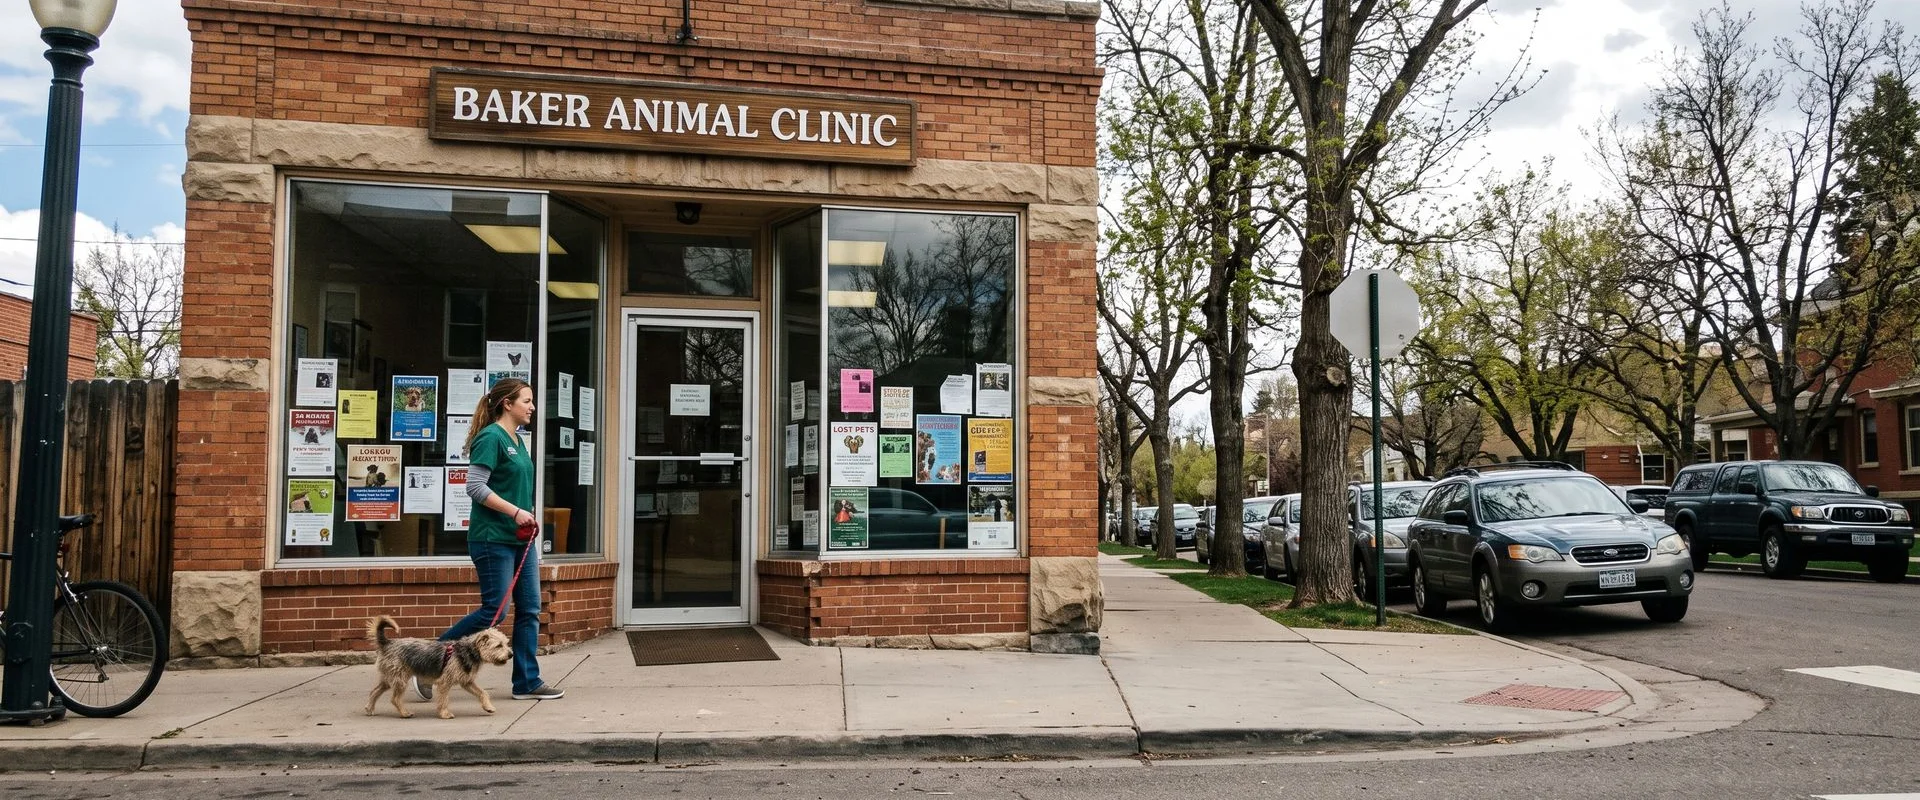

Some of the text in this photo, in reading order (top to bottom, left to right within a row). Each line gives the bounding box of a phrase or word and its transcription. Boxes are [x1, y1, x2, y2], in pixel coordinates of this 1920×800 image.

[452, 86, 897, 147] BAKER ANIMAL CLINIC
